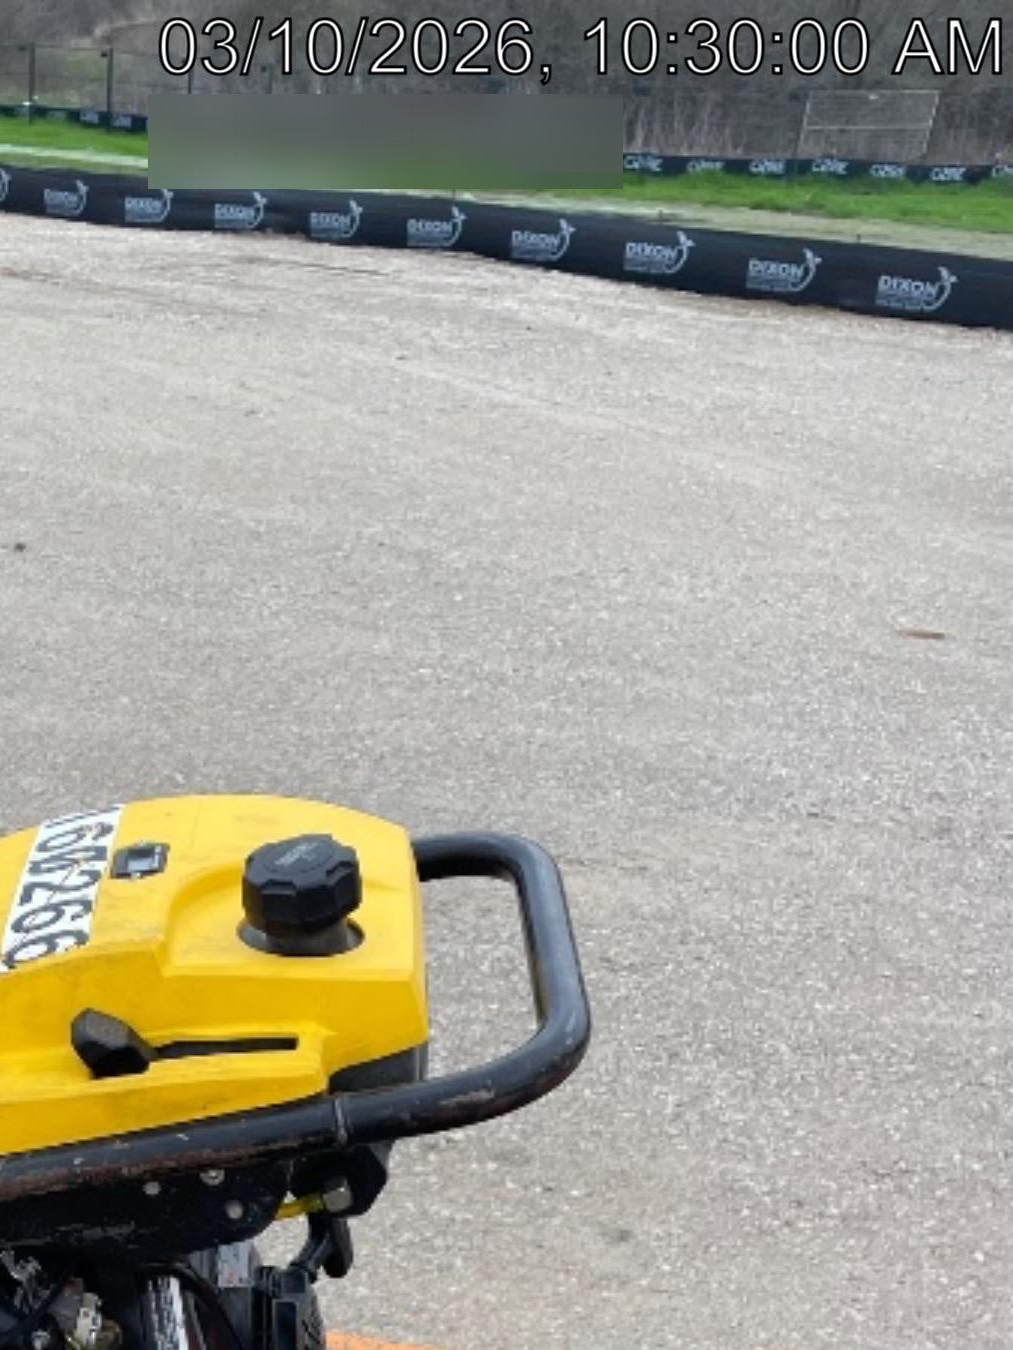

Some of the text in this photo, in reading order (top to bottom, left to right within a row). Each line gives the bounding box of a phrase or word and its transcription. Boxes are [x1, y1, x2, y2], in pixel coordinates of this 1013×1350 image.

[625, 242, 678, 262] DIXON
[749, 259, 804, 281] DIXON
[878, 275, 938, 299] DIXON
